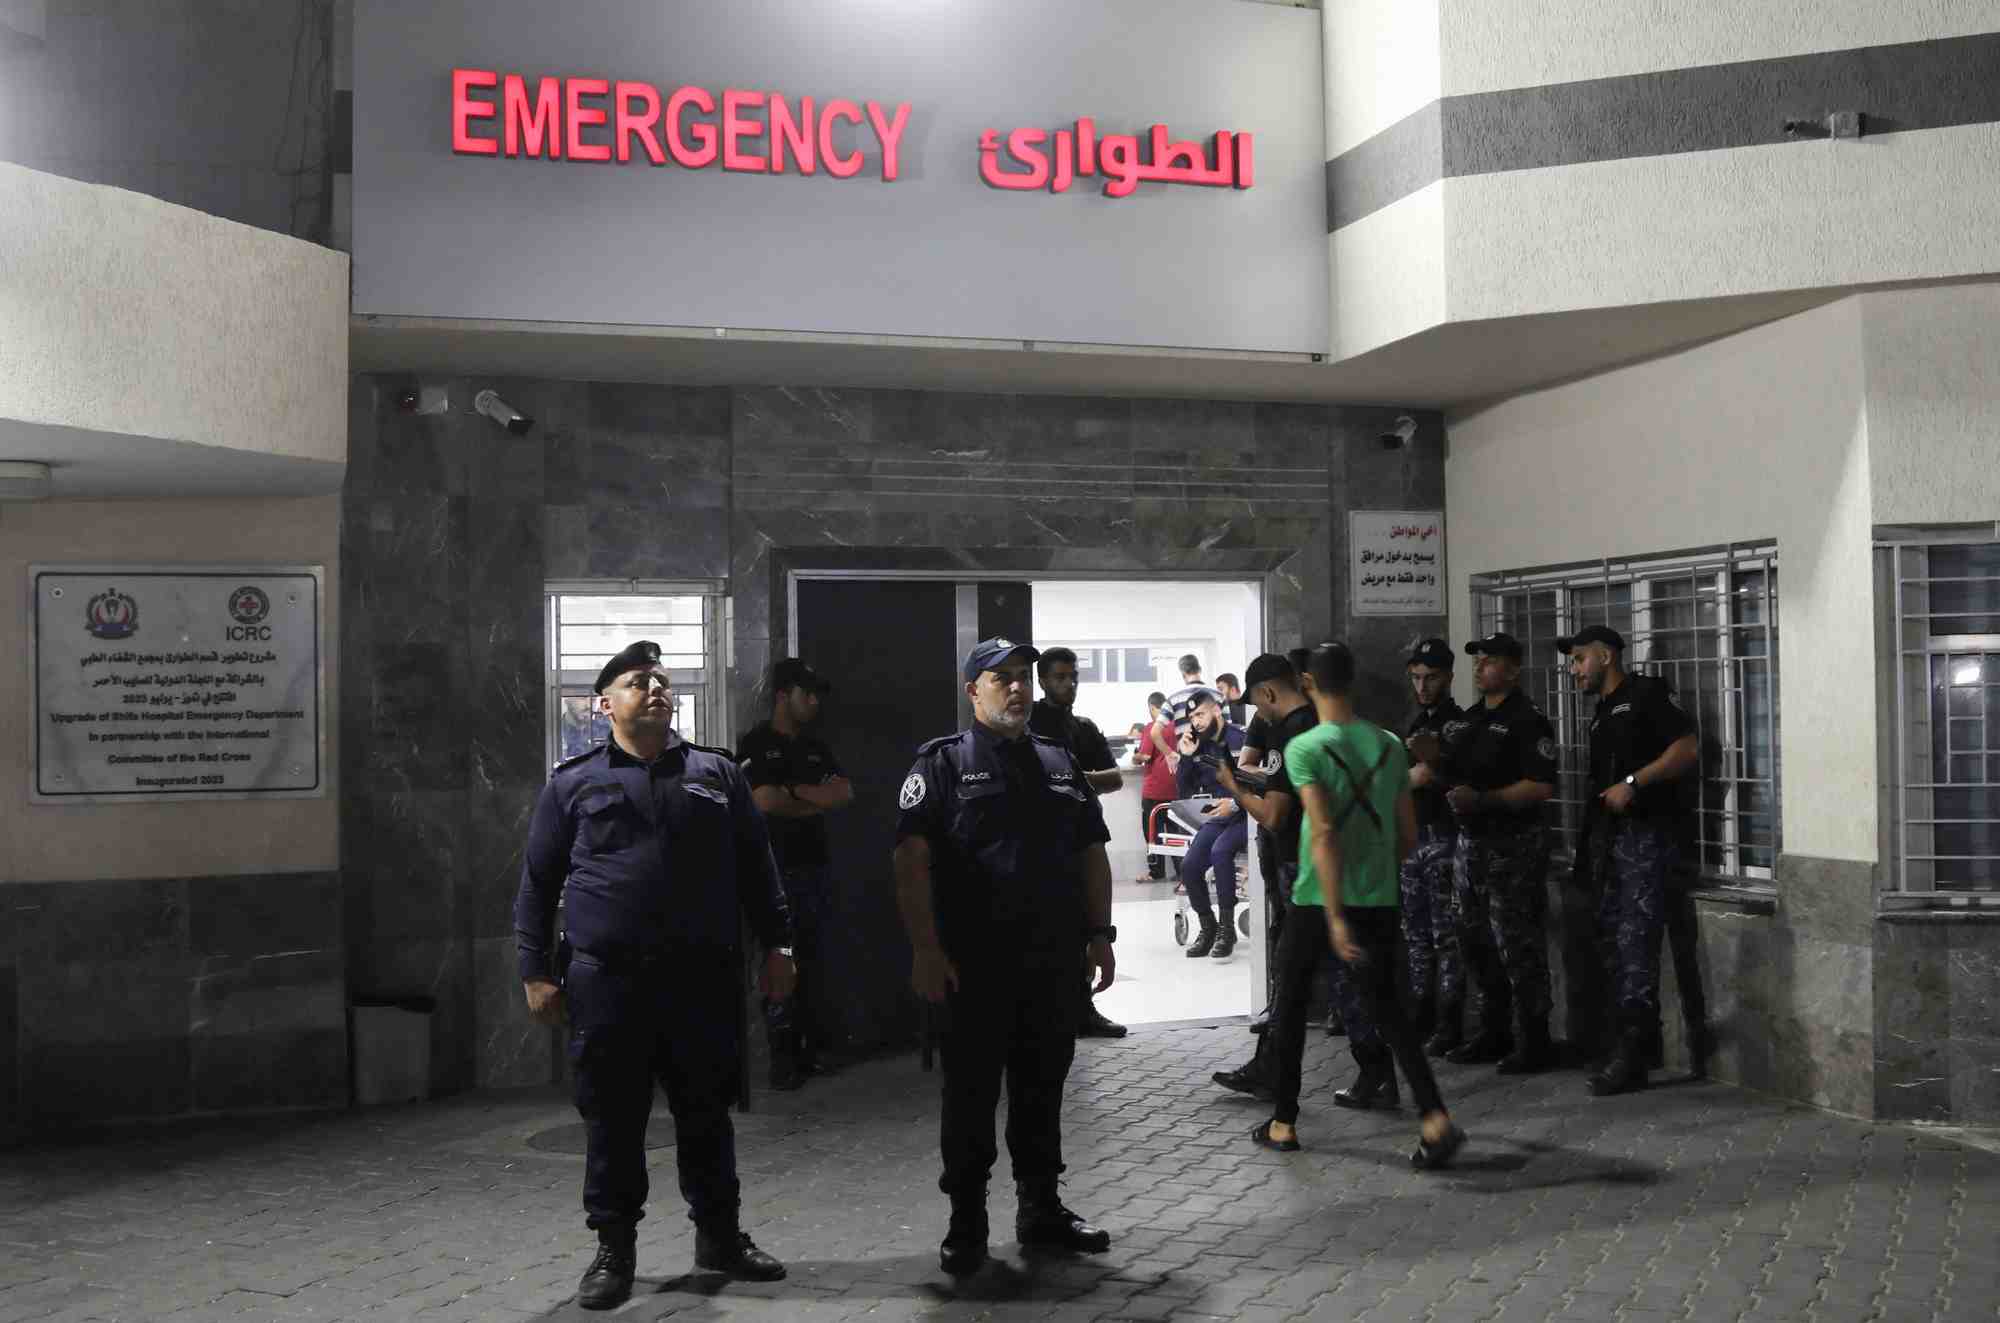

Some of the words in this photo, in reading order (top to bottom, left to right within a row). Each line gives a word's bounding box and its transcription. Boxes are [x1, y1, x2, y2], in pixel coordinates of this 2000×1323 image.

[452, 69, 911, 182] EMERGENCY
[978, 117, 1254, 197] الطوارئ
[1413, 552, 1435, 565] يسمح
[1361, 573, 1385, 586] مريض
[1385, 575, 1396, 587] مع
[1397, 572, 1414, 583] فقط
[226, 626, 272, 641] ICRC
[50, 713, 96, 723] Upgrade
[99, 712, 110, 721] of
[112, 711, 137, 721] Shifa
[142, 711, 183, 721] Hospital
[186, 711, 242, 721] Emergency
[245, 709, 304, 720] Department
[163, 730, 184, 741] with
[187, 731, 203, 740] the
[107, 754, 163, 764] Committee
[167, 754, 178, 763] of
[179, 754, 195, 763] the
[198, 752, 218, 762] Red
[221, 752, 251, 761] Cross
[200, 775, 225, 784] 2023
[961, 771, 991, 783] POLICE
